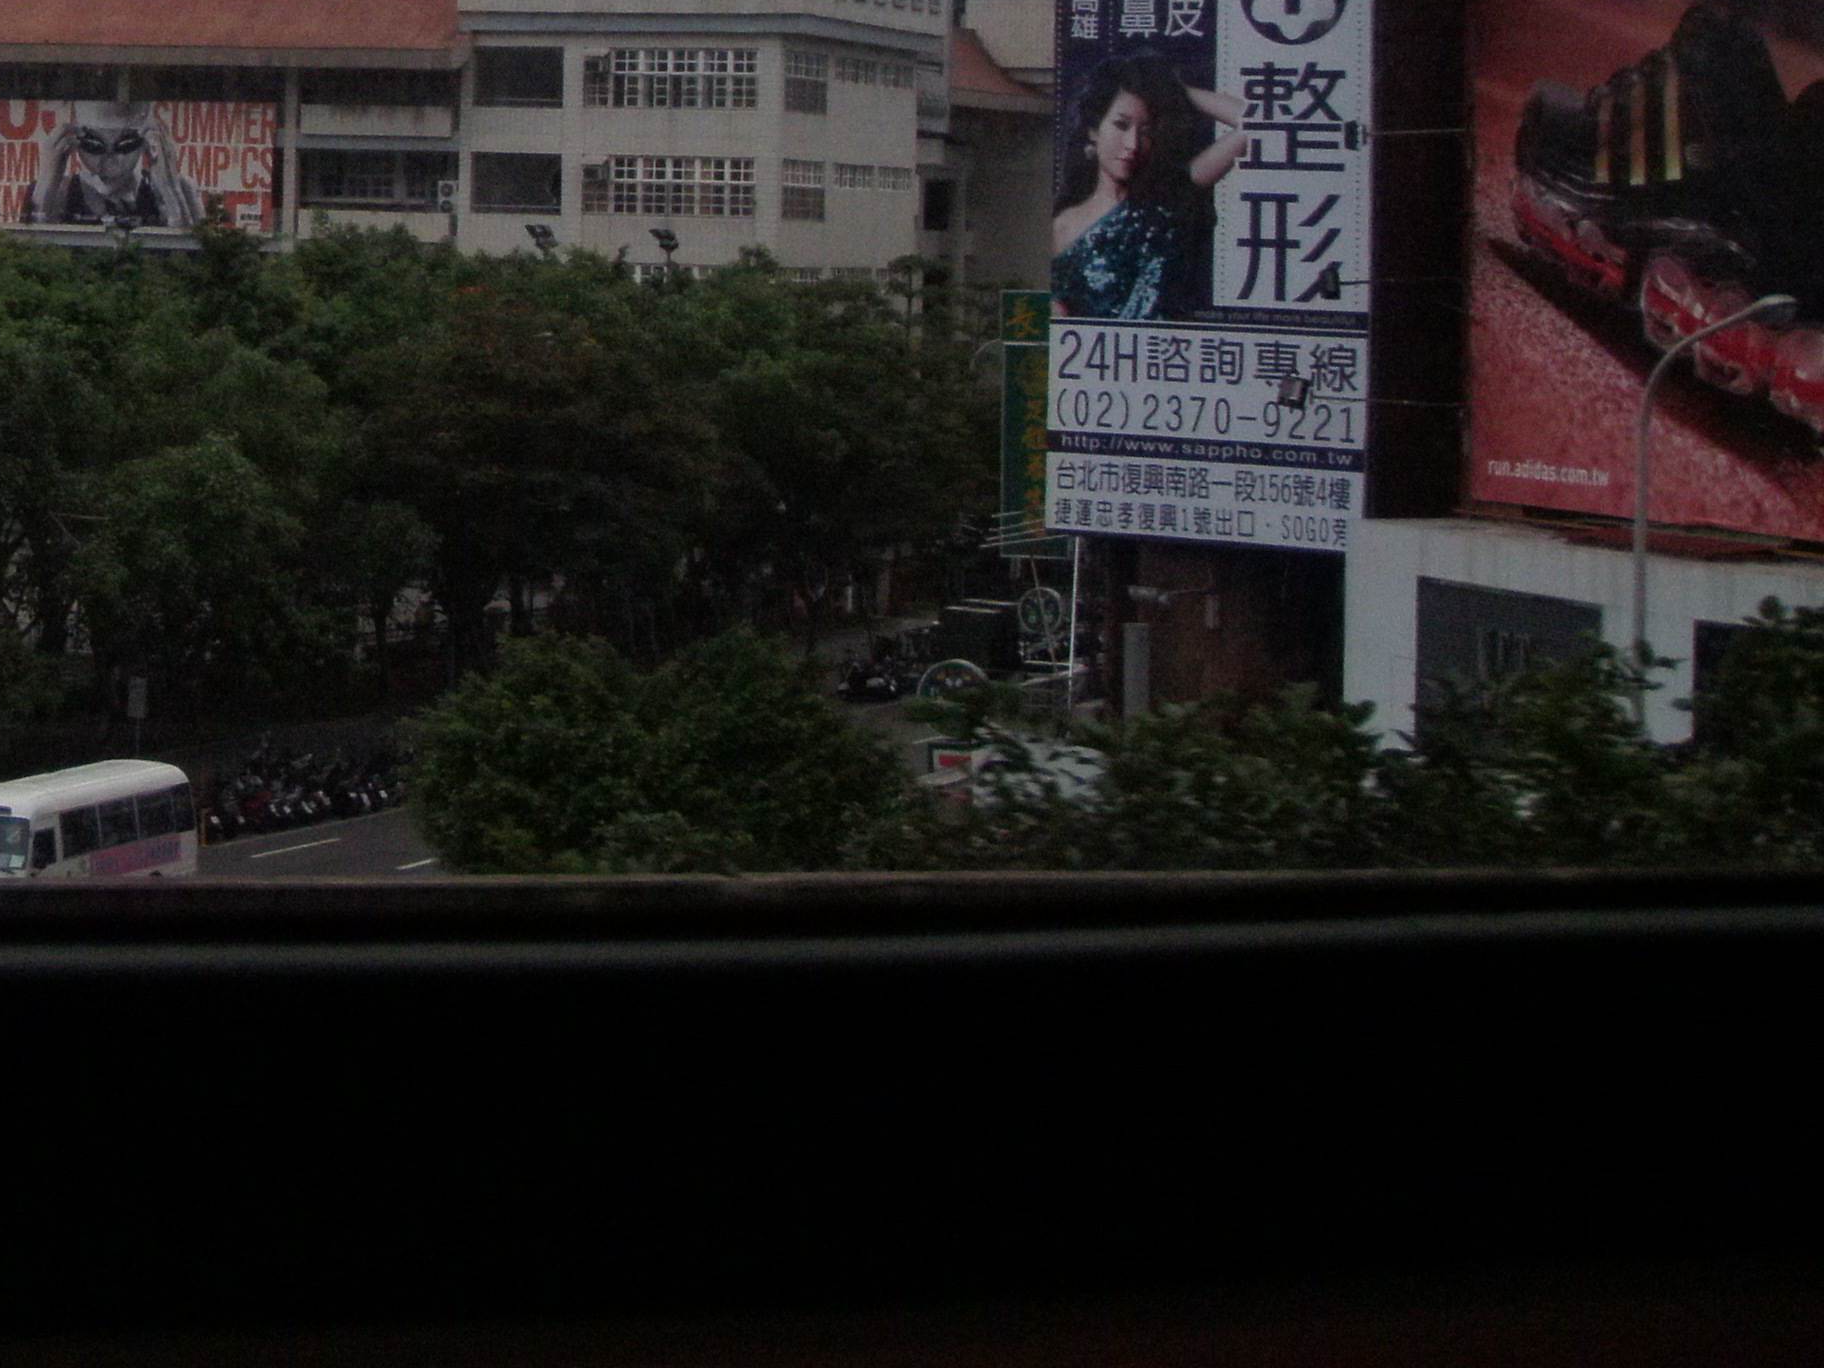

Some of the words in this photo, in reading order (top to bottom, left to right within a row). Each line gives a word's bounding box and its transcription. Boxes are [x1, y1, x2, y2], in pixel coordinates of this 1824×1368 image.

[1236, 62, 1346, 302] 整形
[1057, 388, 1355, 444] (02)2370-9221
[1061, 434, 1353, 467] http://www.sappho.com.tw
[1487, 458, 1610, 486] run.adidas.com.tw
